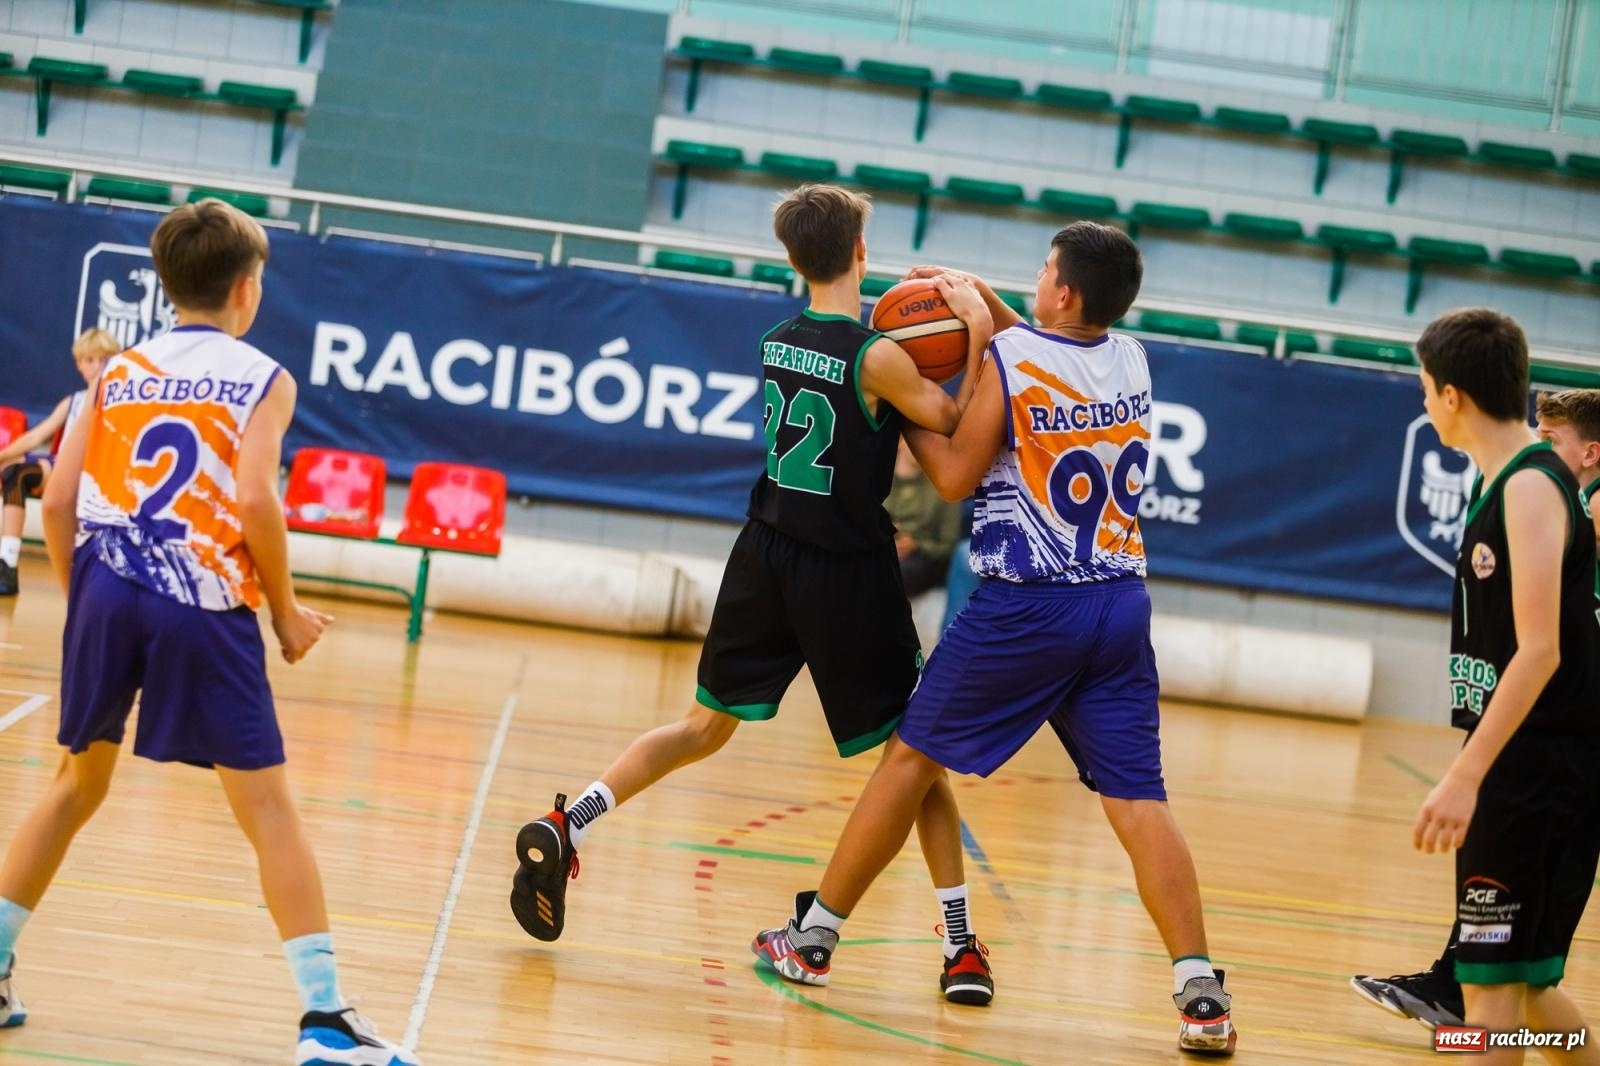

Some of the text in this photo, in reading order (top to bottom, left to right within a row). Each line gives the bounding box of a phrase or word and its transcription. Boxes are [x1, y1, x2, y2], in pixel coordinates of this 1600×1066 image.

[898, 297, 946, 317] olten
[104, 371, 255, 406] RACIBÓRZ
[310, 321, 759, 440] RACIBÓRZ
[1029, 391, 1150, 432] RACIBÓRZ
[764, 378, 836, 495] 22
[1145, 401, 1207, 492] R
[130, 414, 192, 545] 2
[1139, 486, 1201, 524] ÓRZ
[1466, 888, 1498, 903] PGE
